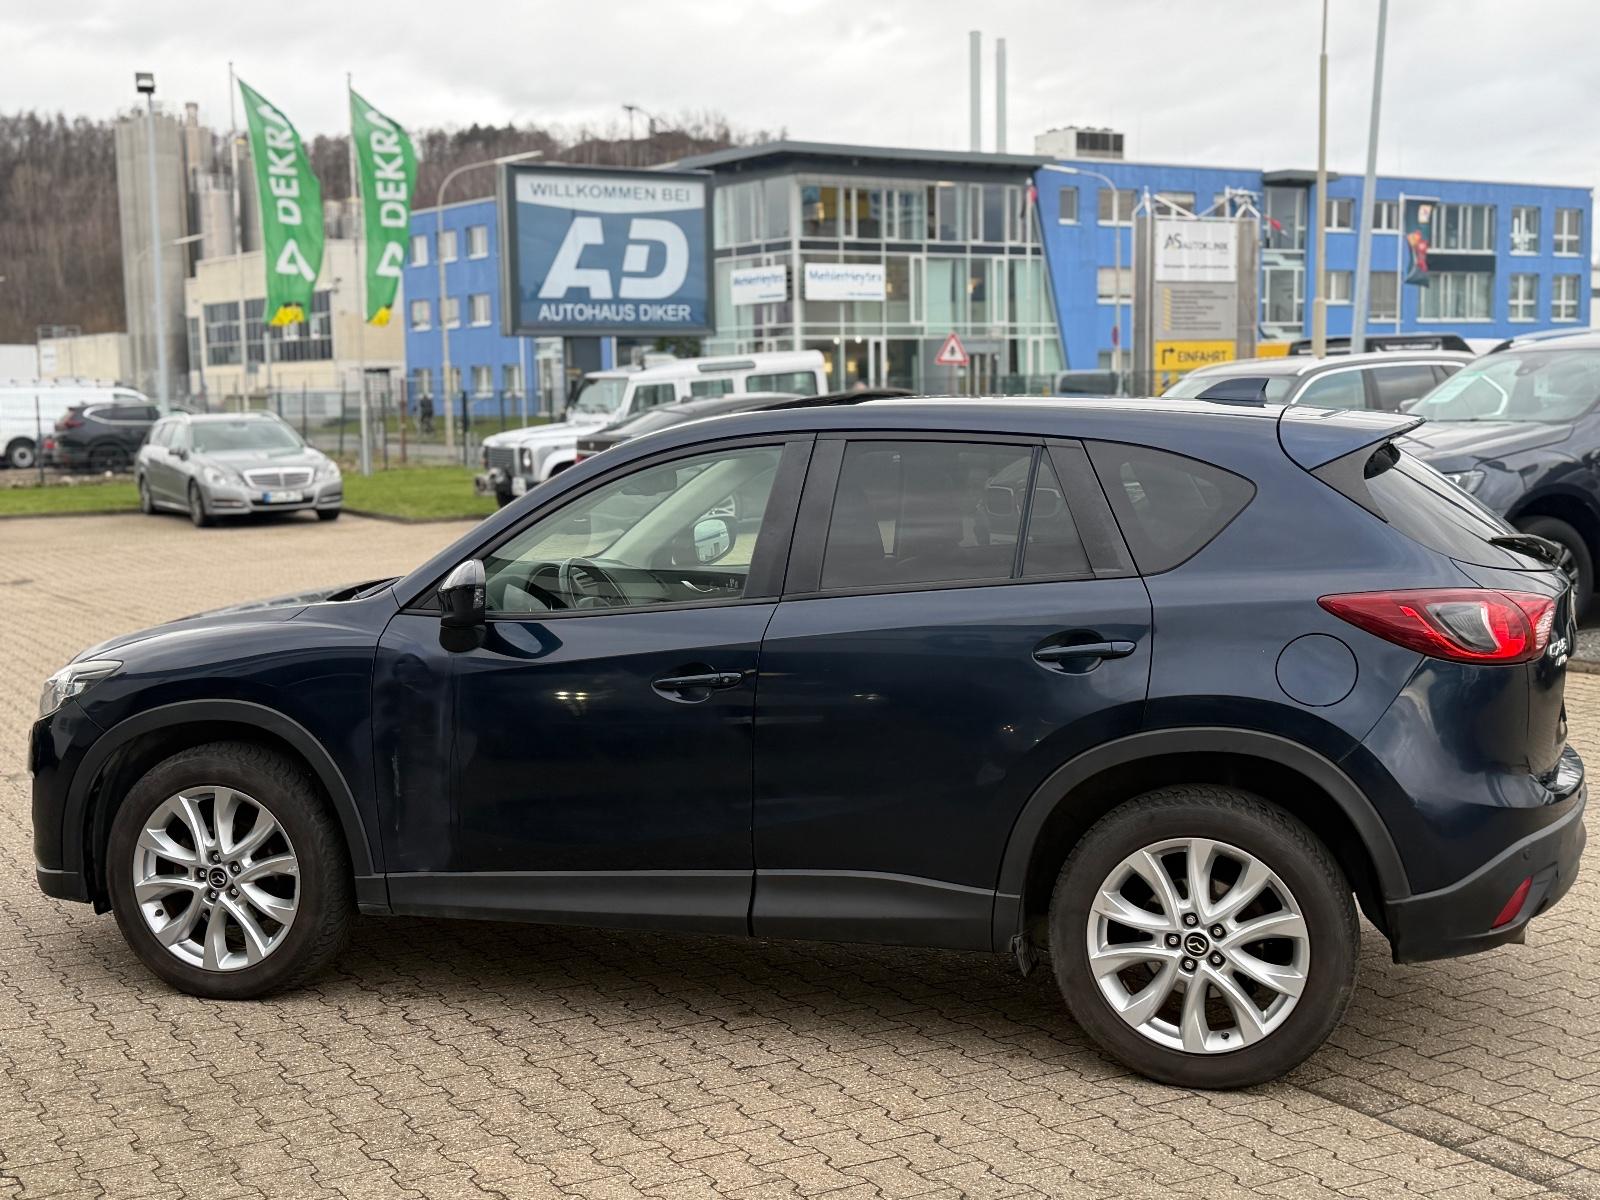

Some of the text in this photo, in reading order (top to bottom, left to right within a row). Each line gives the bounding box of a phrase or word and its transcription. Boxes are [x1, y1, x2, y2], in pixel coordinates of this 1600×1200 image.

[530, 182, 691, 203] WILLKOMMEN BEI
[538, 303, 691, 322] AUTOHAUS DIKER
[1177, 349, 1227, 363] EINFAHRT
